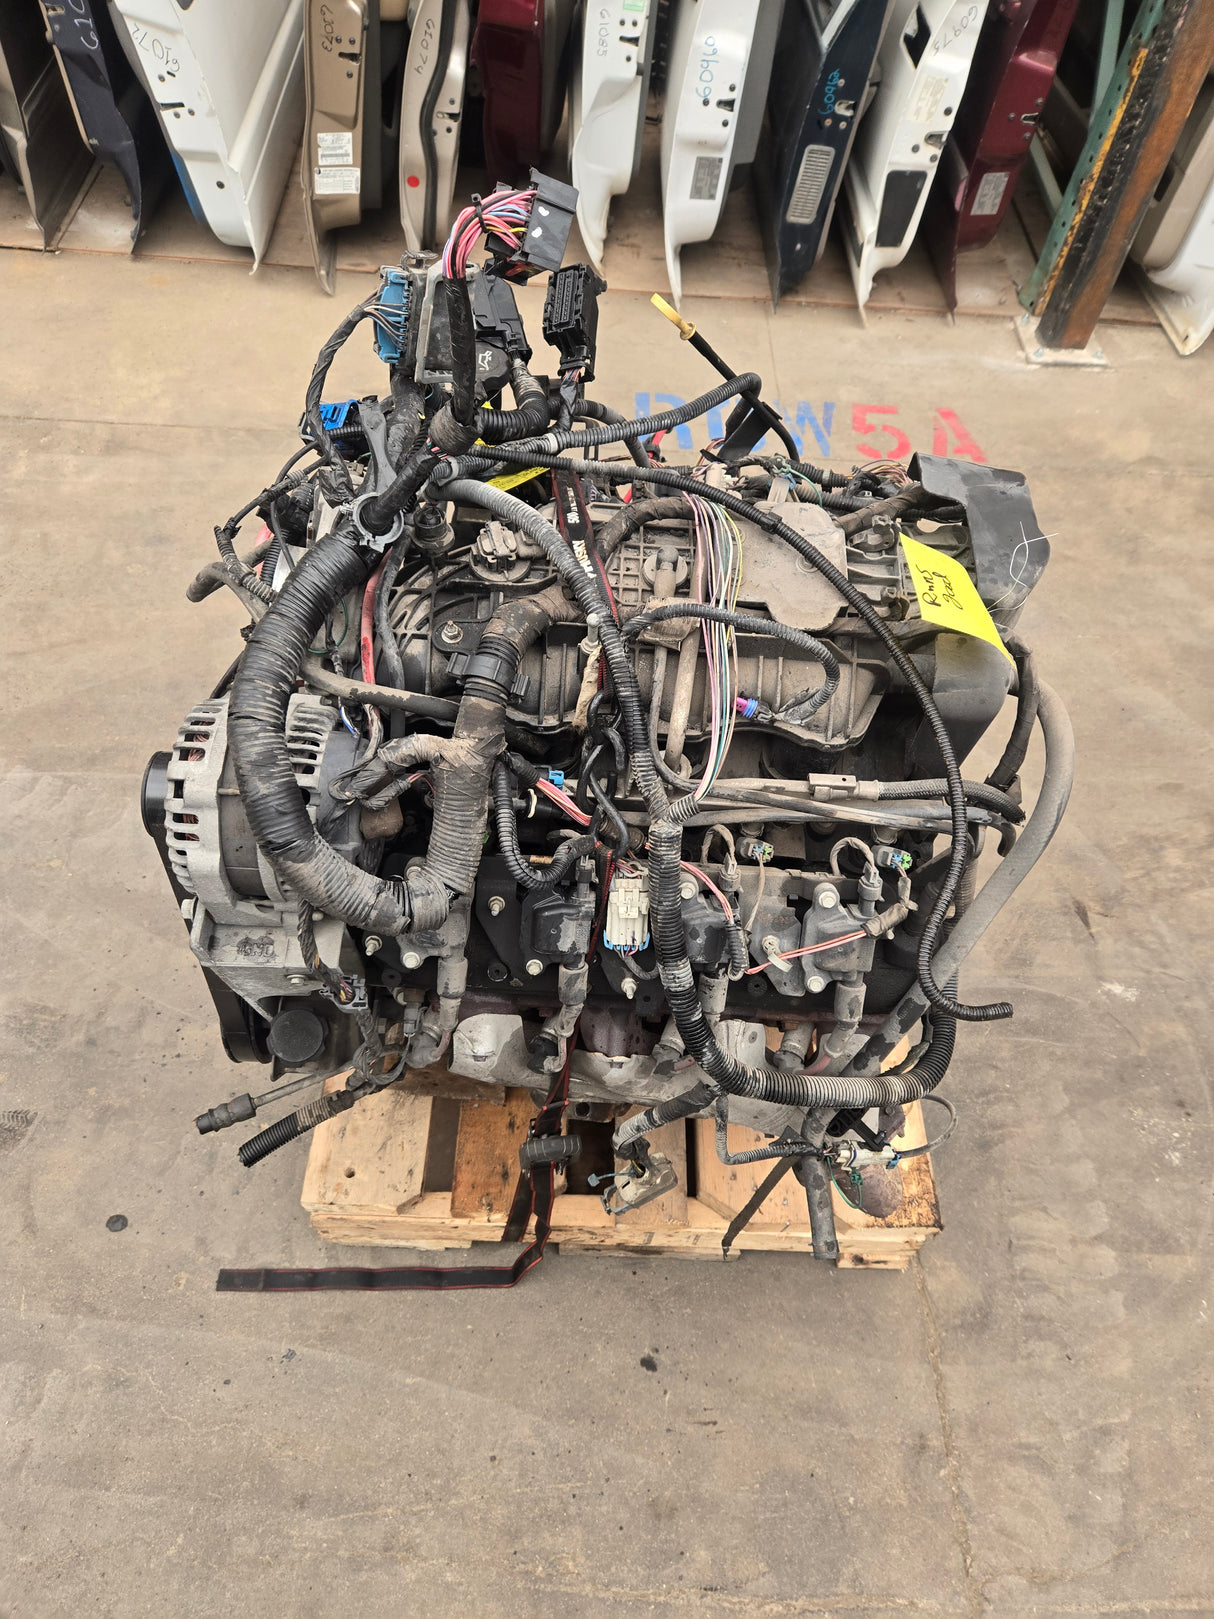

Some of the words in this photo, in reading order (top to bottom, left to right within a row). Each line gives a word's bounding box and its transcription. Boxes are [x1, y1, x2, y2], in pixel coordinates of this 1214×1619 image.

[131, 23, 181, 74] 61072
[695, 35, 720, 101] 60960
[851, 403, 911, 461] 5
[932, 407, 988, 463] A
